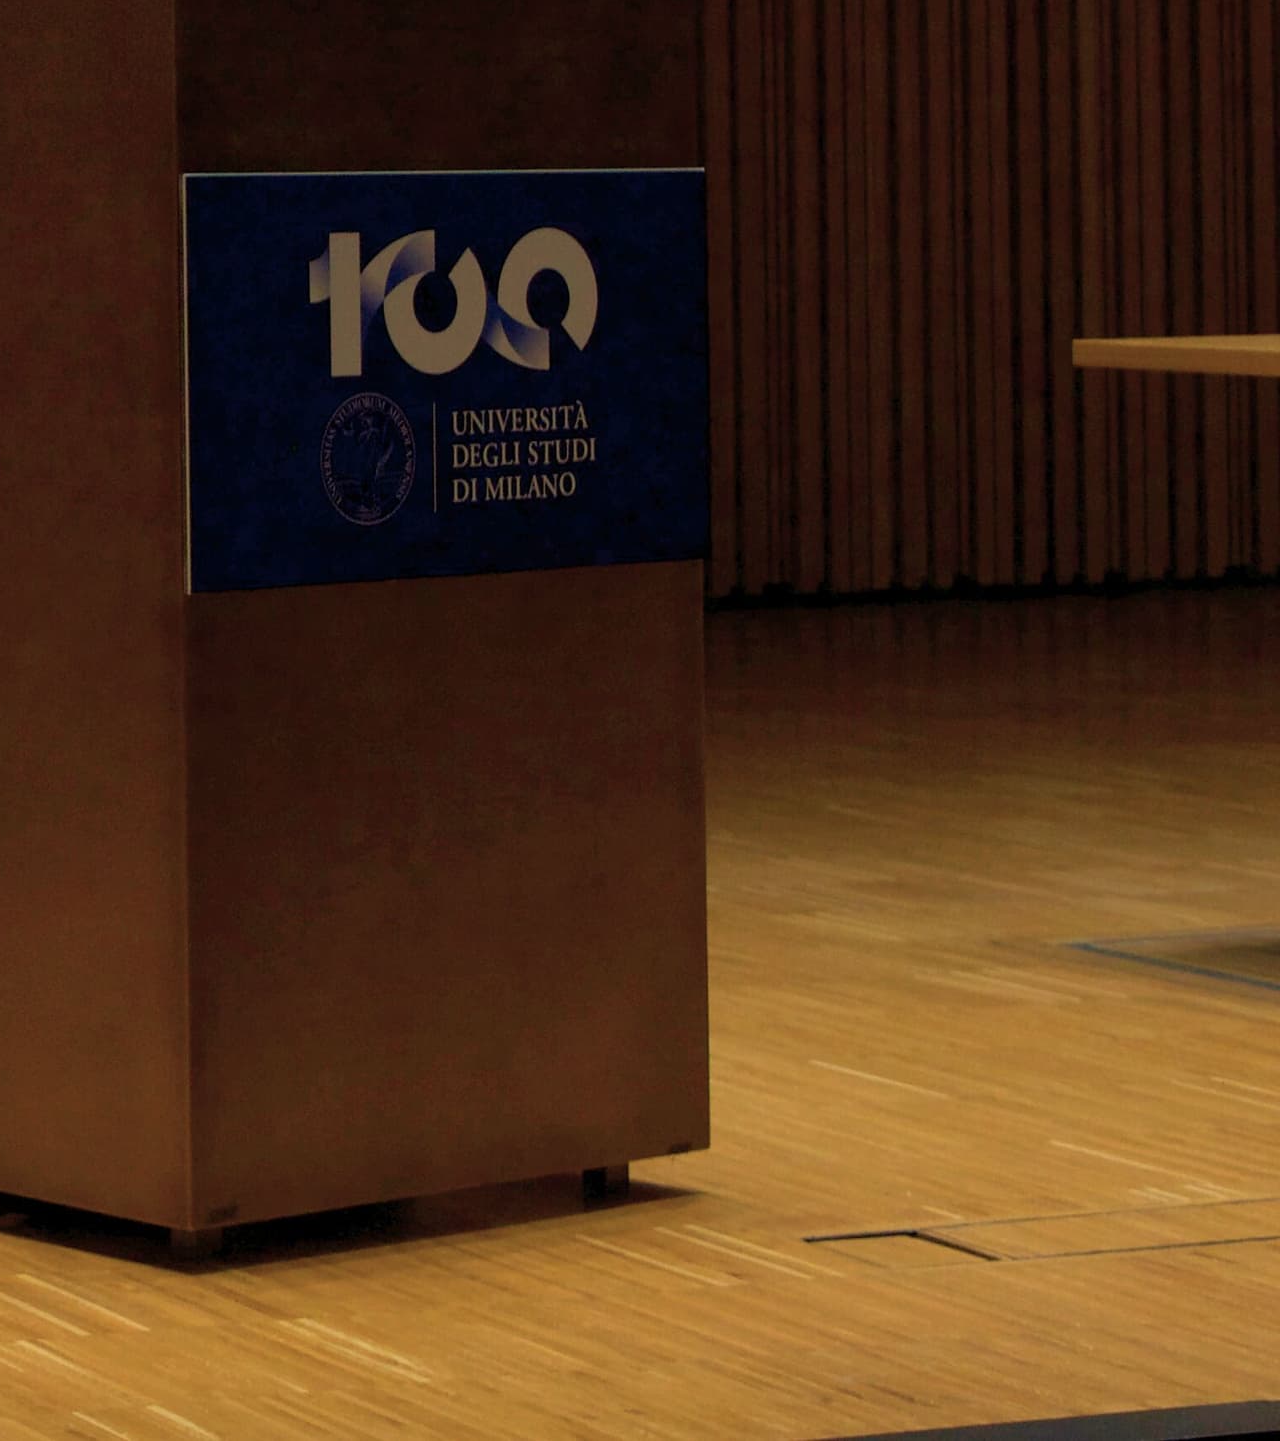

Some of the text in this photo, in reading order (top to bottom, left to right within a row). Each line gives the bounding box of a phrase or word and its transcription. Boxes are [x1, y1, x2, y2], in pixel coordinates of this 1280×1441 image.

[308, 226, 599, 378] 100
[451, 399, 589, 436] UNIVERSITÀ
[452, 437, 597, 468] DEGLI STUDI
[452, 471, 577, 503] DI MILANO
